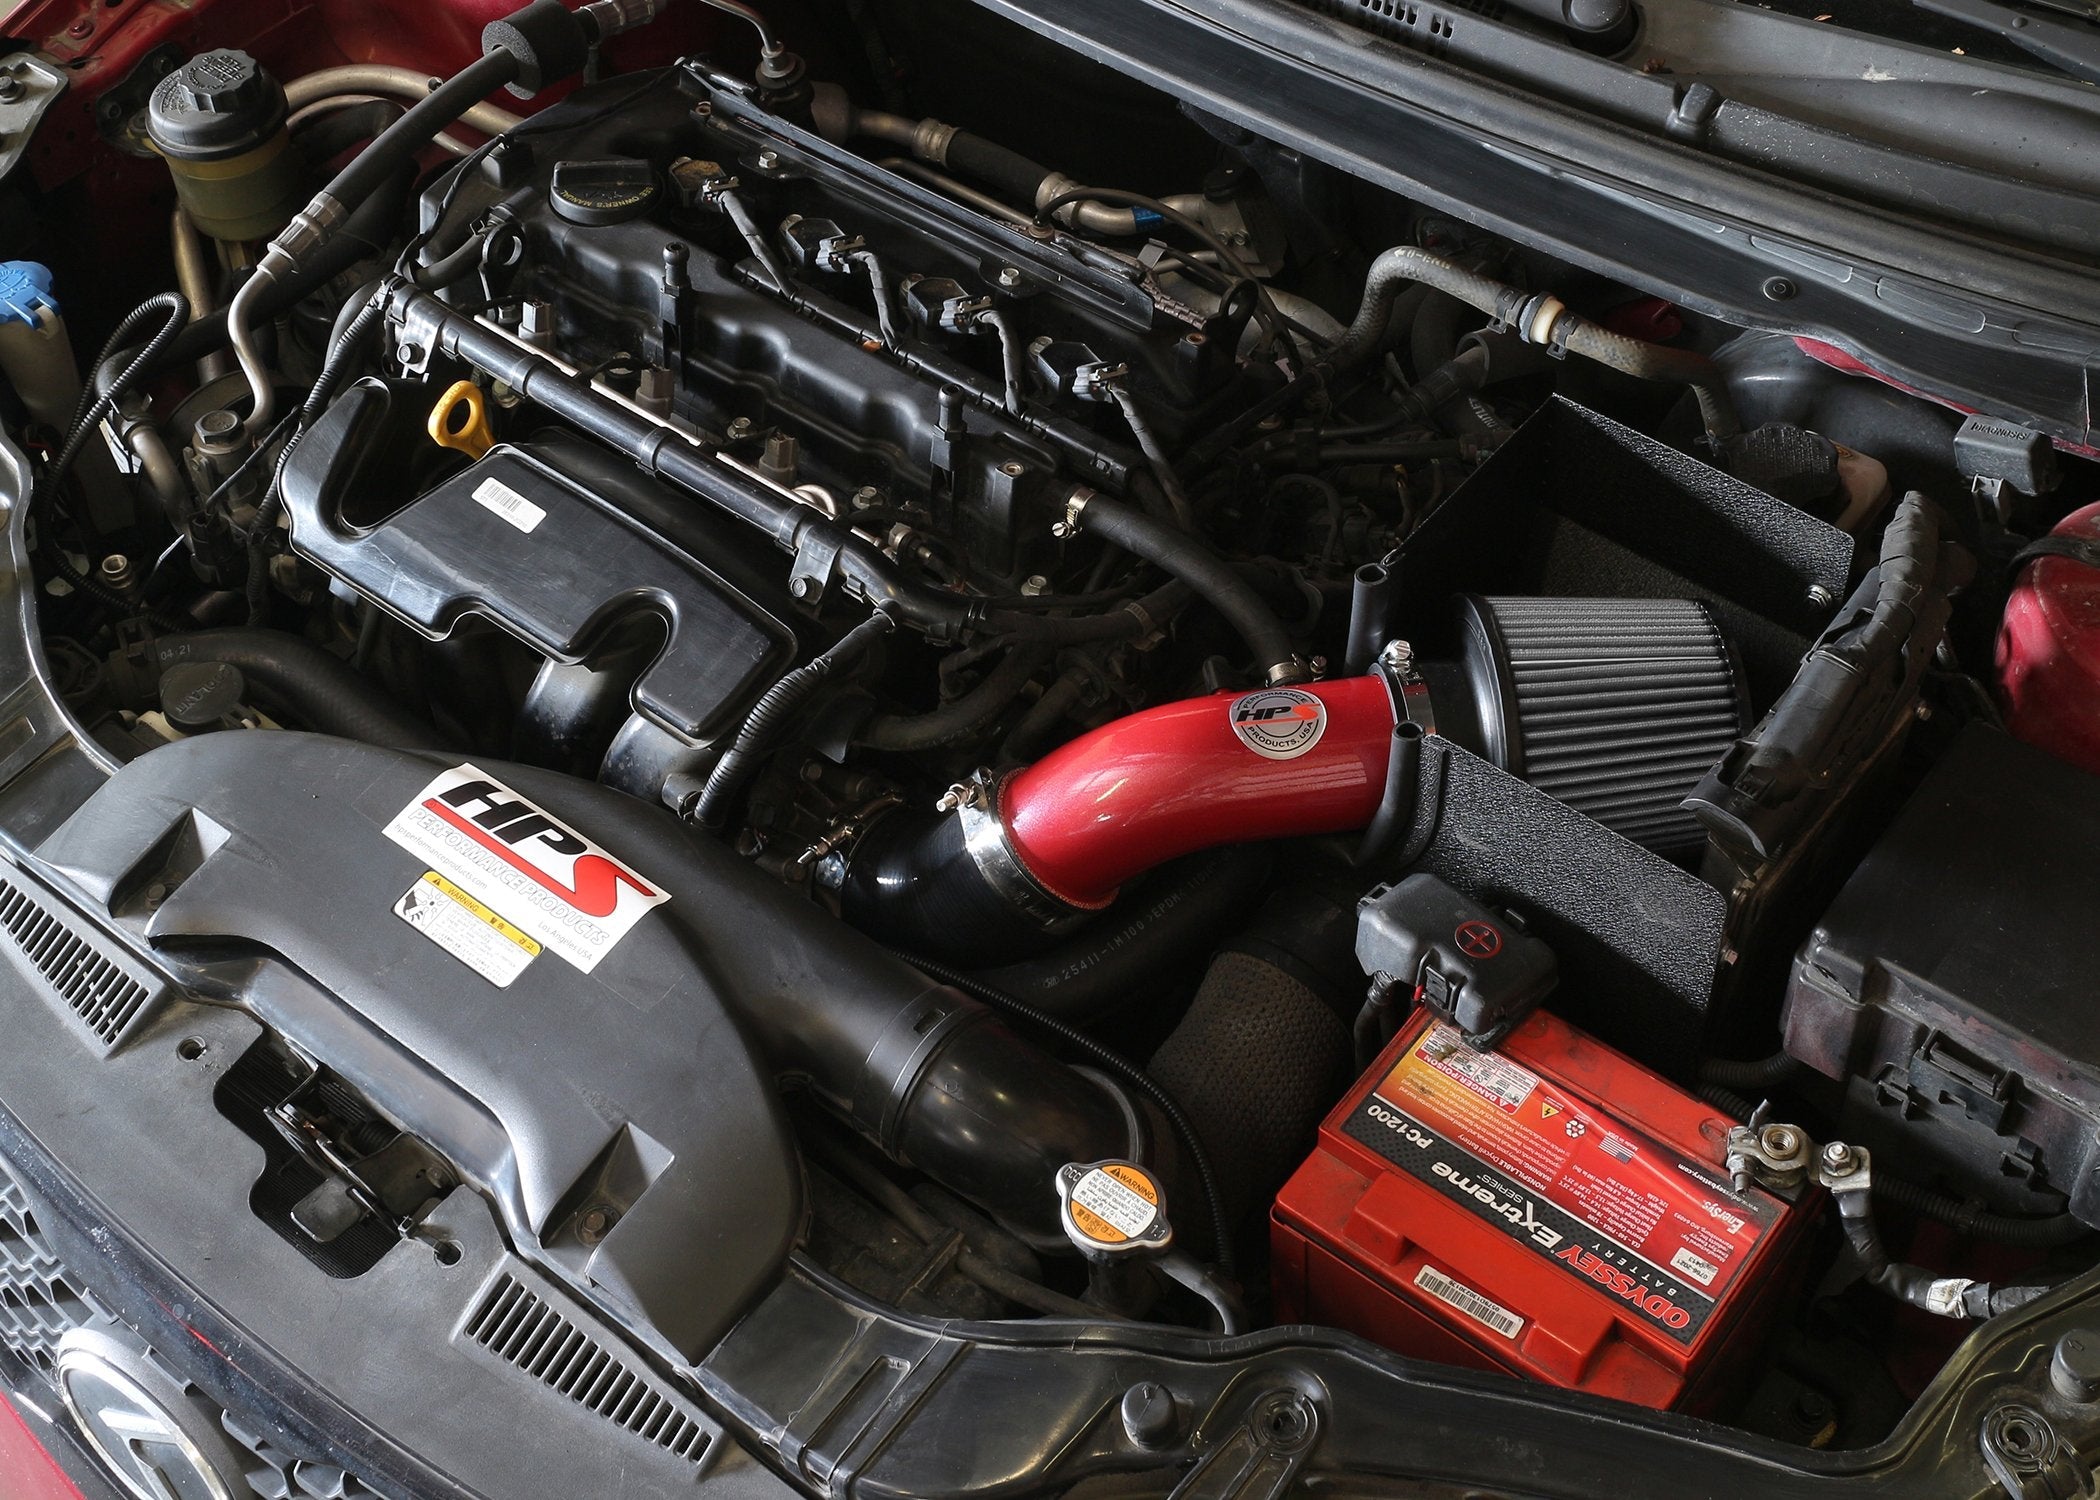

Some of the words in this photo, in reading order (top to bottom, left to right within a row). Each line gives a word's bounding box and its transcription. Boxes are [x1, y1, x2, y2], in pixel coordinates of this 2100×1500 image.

[560, 190, 593, 207] MANUAL
[1235, 704, 1320, 727] HPS
[1243, 691, 1308, 709] PERFORMANCE
[1299, 721, 1314, 740] USA
[391, 822, 490, 891] hpsperformanceproducts.com
[422, 780, 657, 918] HPS
[405, 806, 528, 891] PERFORMANCE
[516, 880, 610, 948] PRODUCTS
[446, 887, 480, 912] WARNING
[536, 919, 554, 933] Los
[547, 928, 579, 952] Angeles
[573, 945, 595, 961] USA
[1423, 1055, 1498, 1100] DANGER/POISON
[1366, 1103, 1433, 1148] PC1200
[1455, 1132, 1481, 1150] Battery
[1476, 1145, 1501, 1162] Drycell
[1110, 1181, 1126, 1194] OPEN
[1117, 1172, 1156, 1200] WARNING
[1496, 1158, 1547, 1191] NONSPILLABLE
[1676, 1163, 1760, 1213] www.odysseybattery.com
[1430, 1158, 1564, 1249] Extreme
[1702, 1199, 1745, 1234] EnerSys
[1687, 1237, 1727, 1263] Manufactured
[1555, 1244, 1690, 1329] ODYSSEY
[1592, 1243, 1677, 1297] BATTERY
